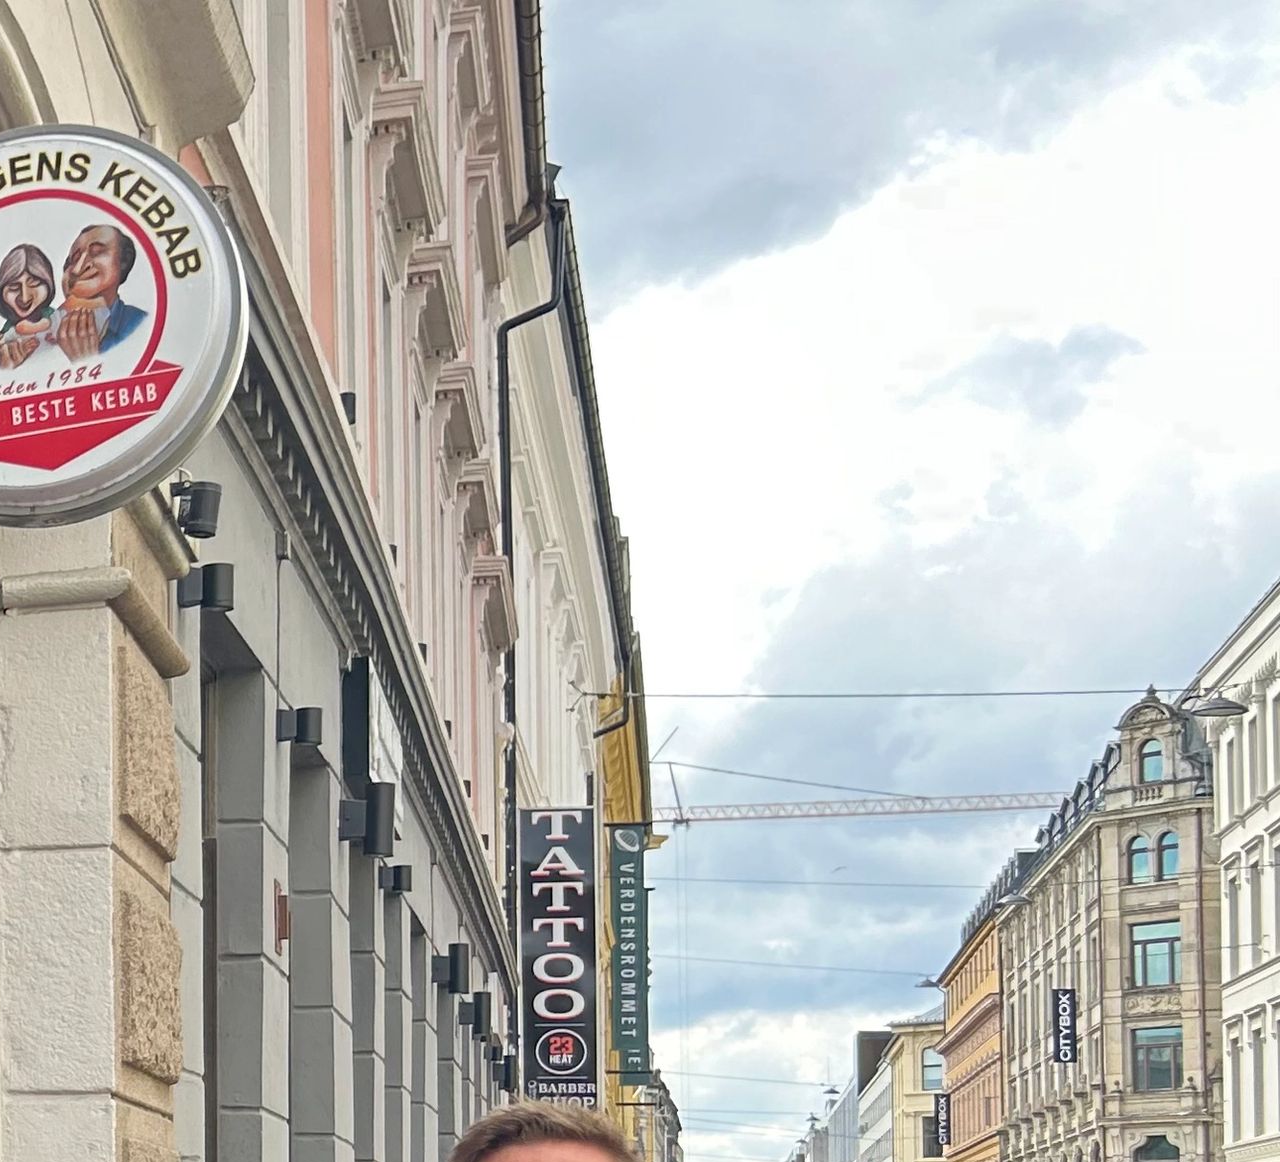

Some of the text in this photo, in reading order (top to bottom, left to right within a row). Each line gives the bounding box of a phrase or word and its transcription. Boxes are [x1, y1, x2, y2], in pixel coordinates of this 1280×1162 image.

[97, 161, 202, 280] KEBAB
[46, 362, 103, 390] 1984
[12, 396, 77, 425] BESTE
[91, 382, 159, 412] KEBAB
[530, 810, 586, 1021] TATTOO
[618, 862, 637, 1038] VERDENSROMMET
[548, 1036, 574, 1054] 23
[1058, 992, 1072, 1062] CITYBOX
[549, 1054, 574, 1064] HEAT
[538, 1082, 596, 1094] BARBER
[938, 1096, 947, 1144] CITYBOX
